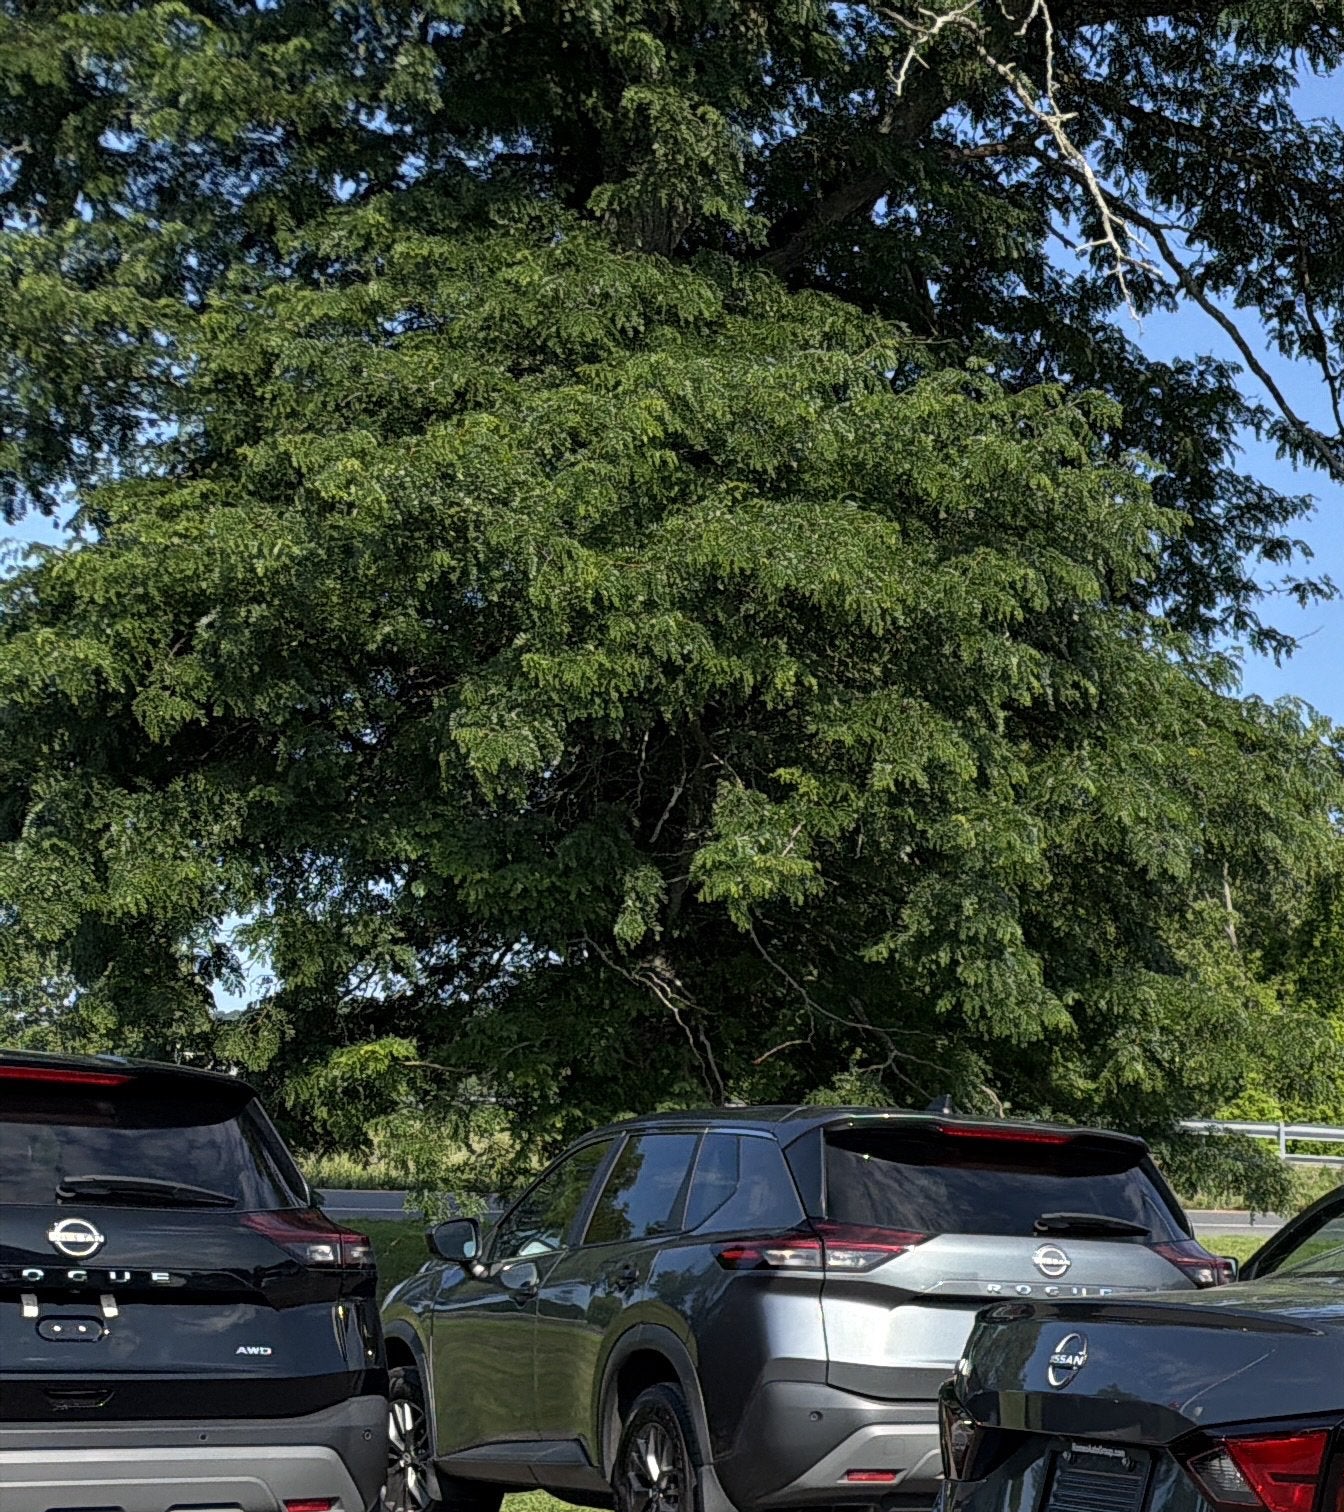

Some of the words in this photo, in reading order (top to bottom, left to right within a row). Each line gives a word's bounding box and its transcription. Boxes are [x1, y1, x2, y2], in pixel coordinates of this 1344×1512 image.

[21, 1268, 171, 1283] OGUE
[986, 1283, 1113, 1297] ROGUE
[235, 1345, 273, 1356] AWD
